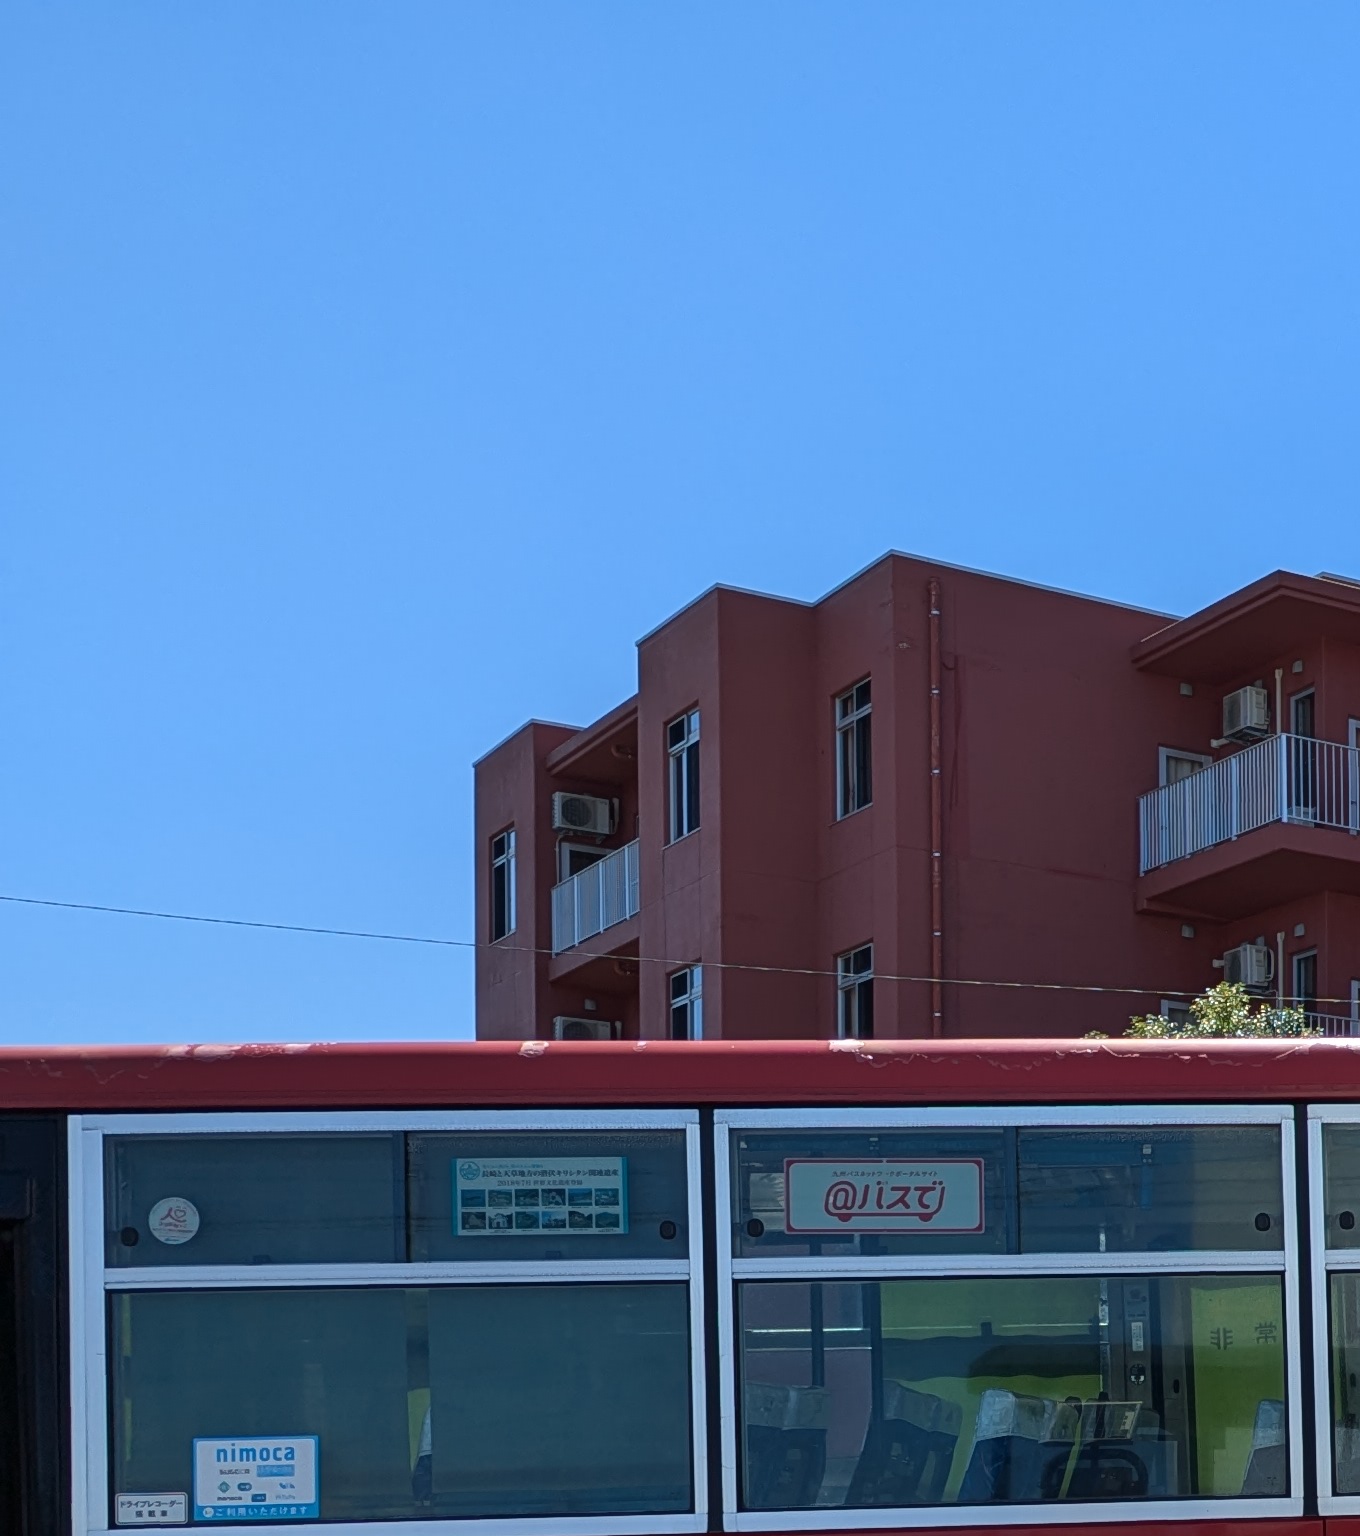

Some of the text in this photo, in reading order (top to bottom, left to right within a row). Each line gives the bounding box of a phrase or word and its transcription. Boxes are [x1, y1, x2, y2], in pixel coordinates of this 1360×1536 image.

[216, 1443, 295, 1463] nimoca
[120, 1500, 183, 1509] ドライブレコーダー
